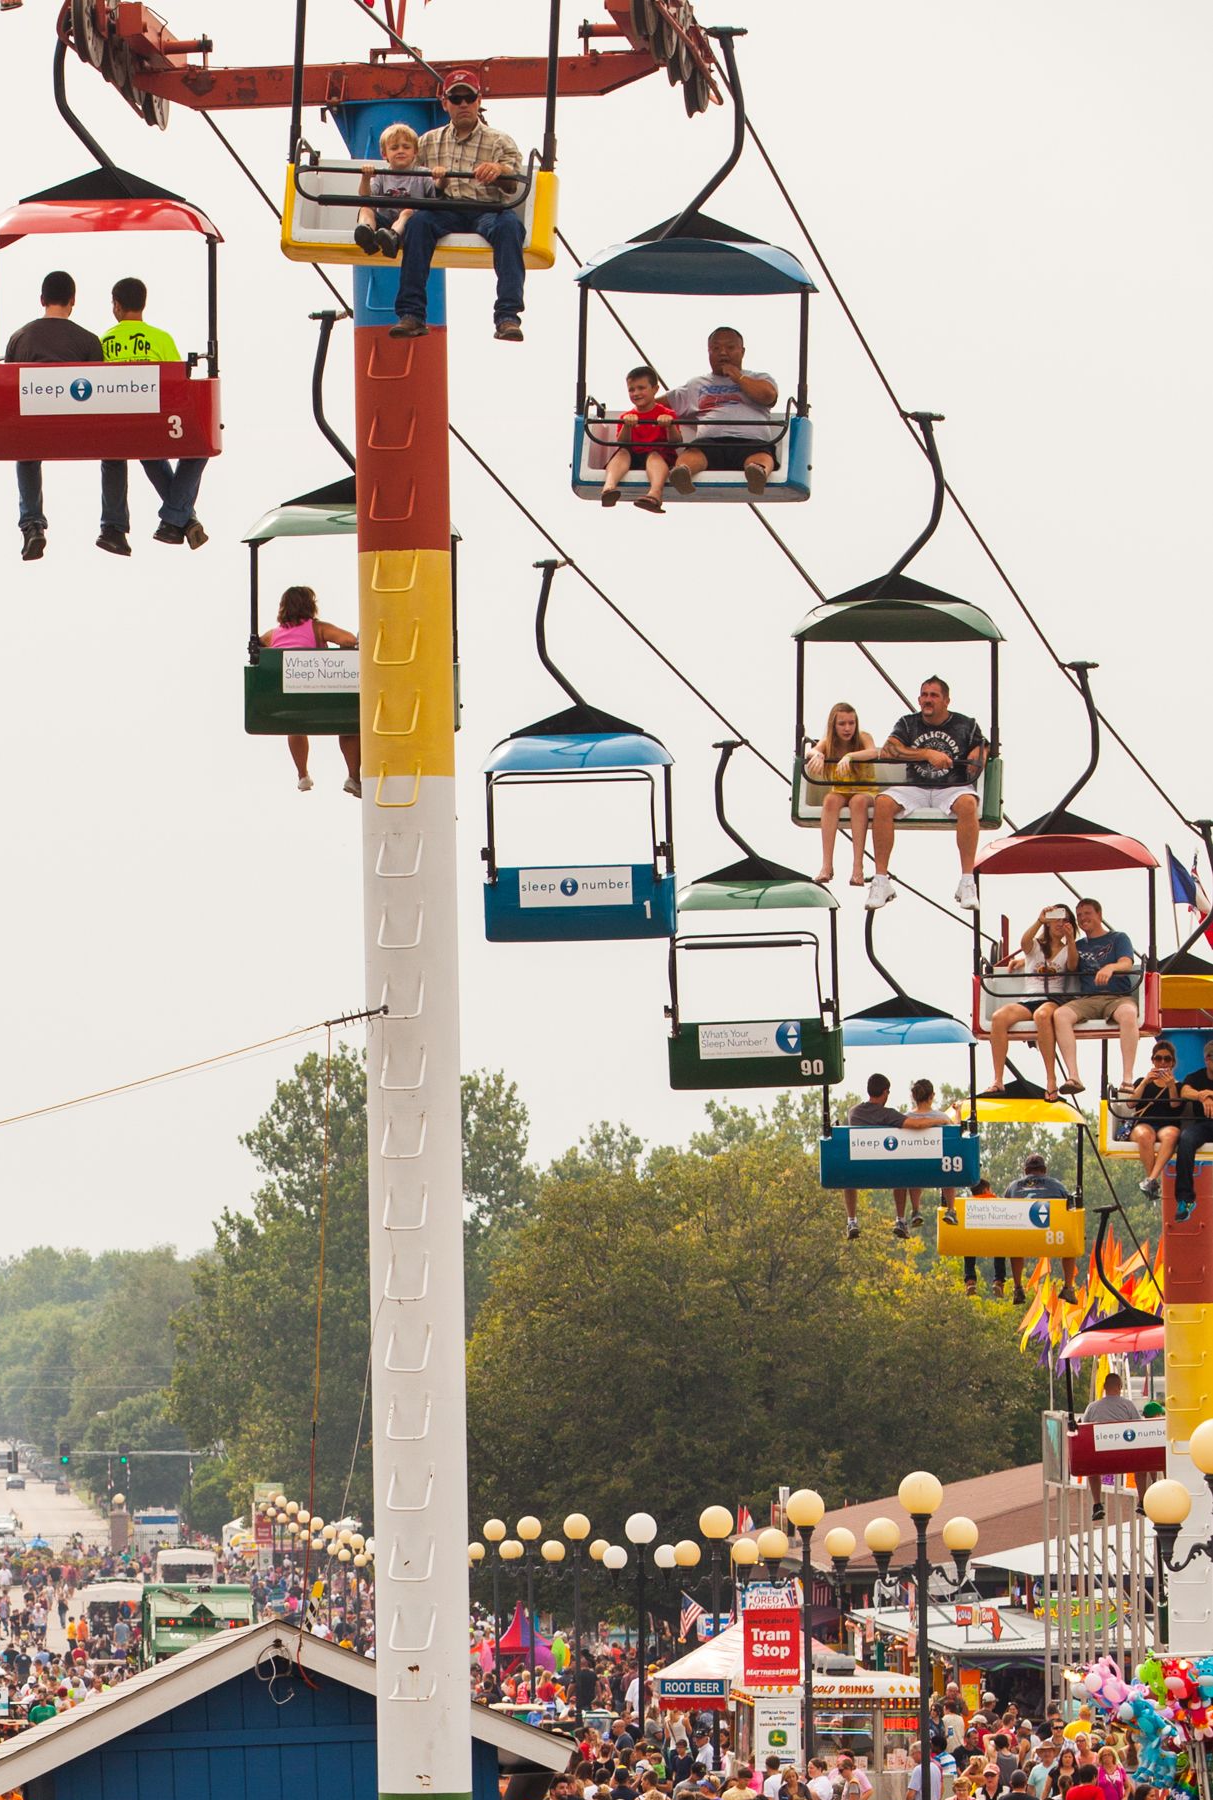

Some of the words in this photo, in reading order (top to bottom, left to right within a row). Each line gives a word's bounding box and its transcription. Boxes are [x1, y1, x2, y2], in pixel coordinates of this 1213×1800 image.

[130, 333, 151, 355] Top
[22, 382, 65, 398] sleep
[96, 380, 157, 394] number
[167, 415, 184, 439] 3
[286, 657, 319, 668] What's
[322, 657, 344, 668] Your
[285, 668, 315, 680] Sleep
[521, 881, 556, 893] sleep
[581, 879, 629, 889] number
[643, 900, 651, 919] 1
[700, 1031, 728, 1039] What's
[730, 1030, 749, 1038] Your
[701, 1040, 725, 1049] Sleep
[727, 1038, 768, 1047] Number?
[801, 1059, 824, 1075] 90
[852, 1139, 880, 1149] sleep
[901, 1137, 941, 1146] number
[941, 1156, 963, 1172] 89
[1045, 1231, 1064, 1244] 88
[1095, 1432, 1120, 1441] sleep
[754, 1595, 779, 1605] OREO
[751, 1628, 791, 1641] Tram
[752, 1644, 791, 1659] Stop
[664, 1682, 691, 1693] ROOT
[694, 1681, 719, 1692] BEER
[812, 1685, 836, 1694] COLD
[839, 1685, 875, 1694] DRINKS
